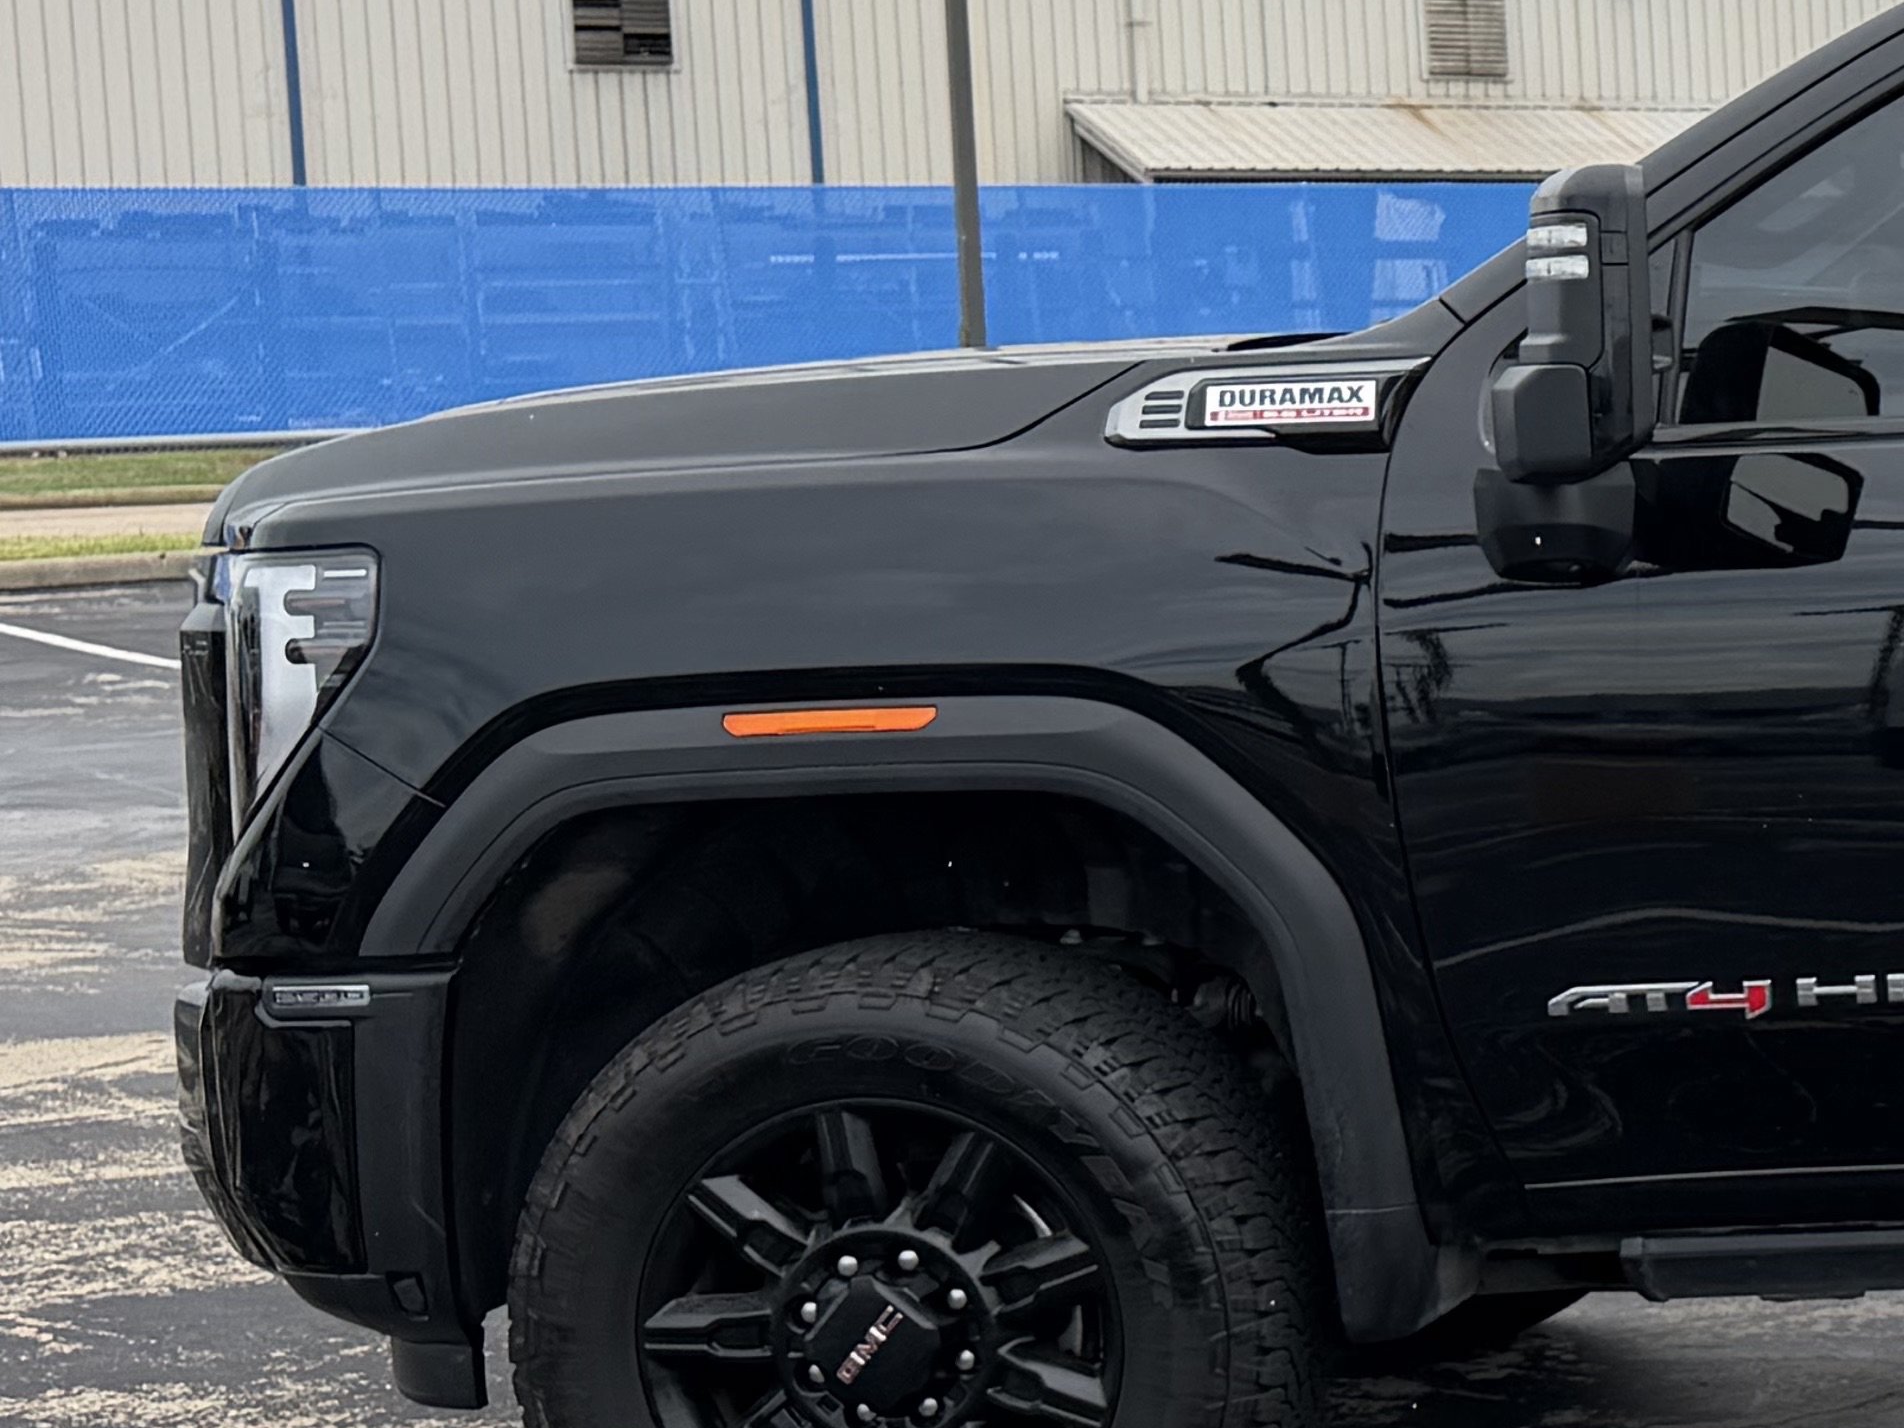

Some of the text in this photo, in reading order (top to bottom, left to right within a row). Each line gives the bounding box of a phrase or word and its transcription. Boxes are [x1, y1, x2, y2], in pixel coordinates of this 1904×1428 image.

[1218, 385, 1364, 408] DURAMAX
[1547, 979, 1772, 1019] AT4
[836, 1304, 905, 1385] GMC
